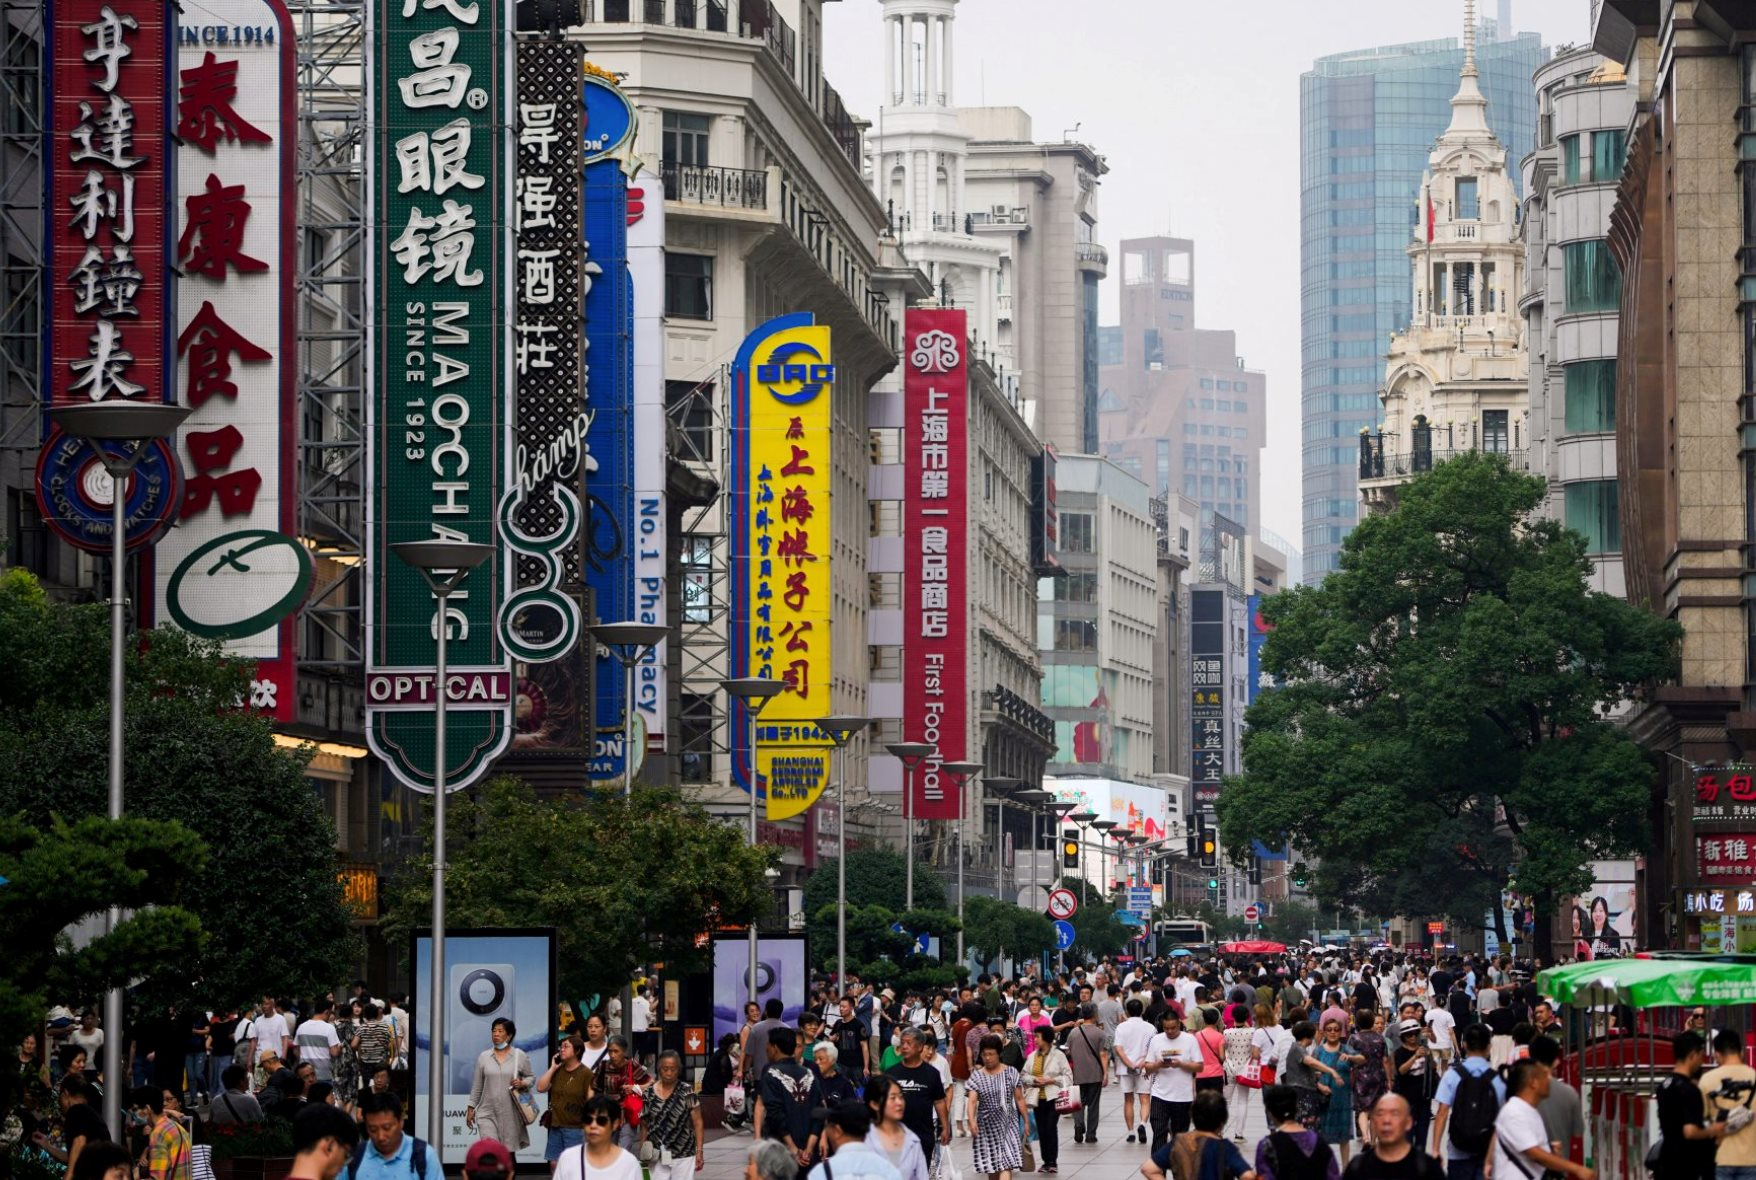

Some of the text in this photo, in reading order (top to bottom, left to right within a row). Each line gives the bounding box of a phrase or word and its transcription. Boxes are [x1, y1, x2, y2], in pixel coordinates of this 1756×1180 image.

[391, 0, 486, 287] 昌眼镜
[178, 51, 273, 519] 泰康食品
[406, 302, 425, 460] SINCE 1923
[516, 408, 596, 492] hamp
[51, 473, 81, 526] CLOCKS
[921, 387, 949, 638] 上海市第一食品商店
[637, 498, 660, 715] No.1 Phamacy
[370, 676, 506, 701] OPTCAL
[924, 654, 944, 800] First Foodhall
[1203, 719, 1222, 780] 真丝大王
[1704, 839, 1756, 861] 新雅
